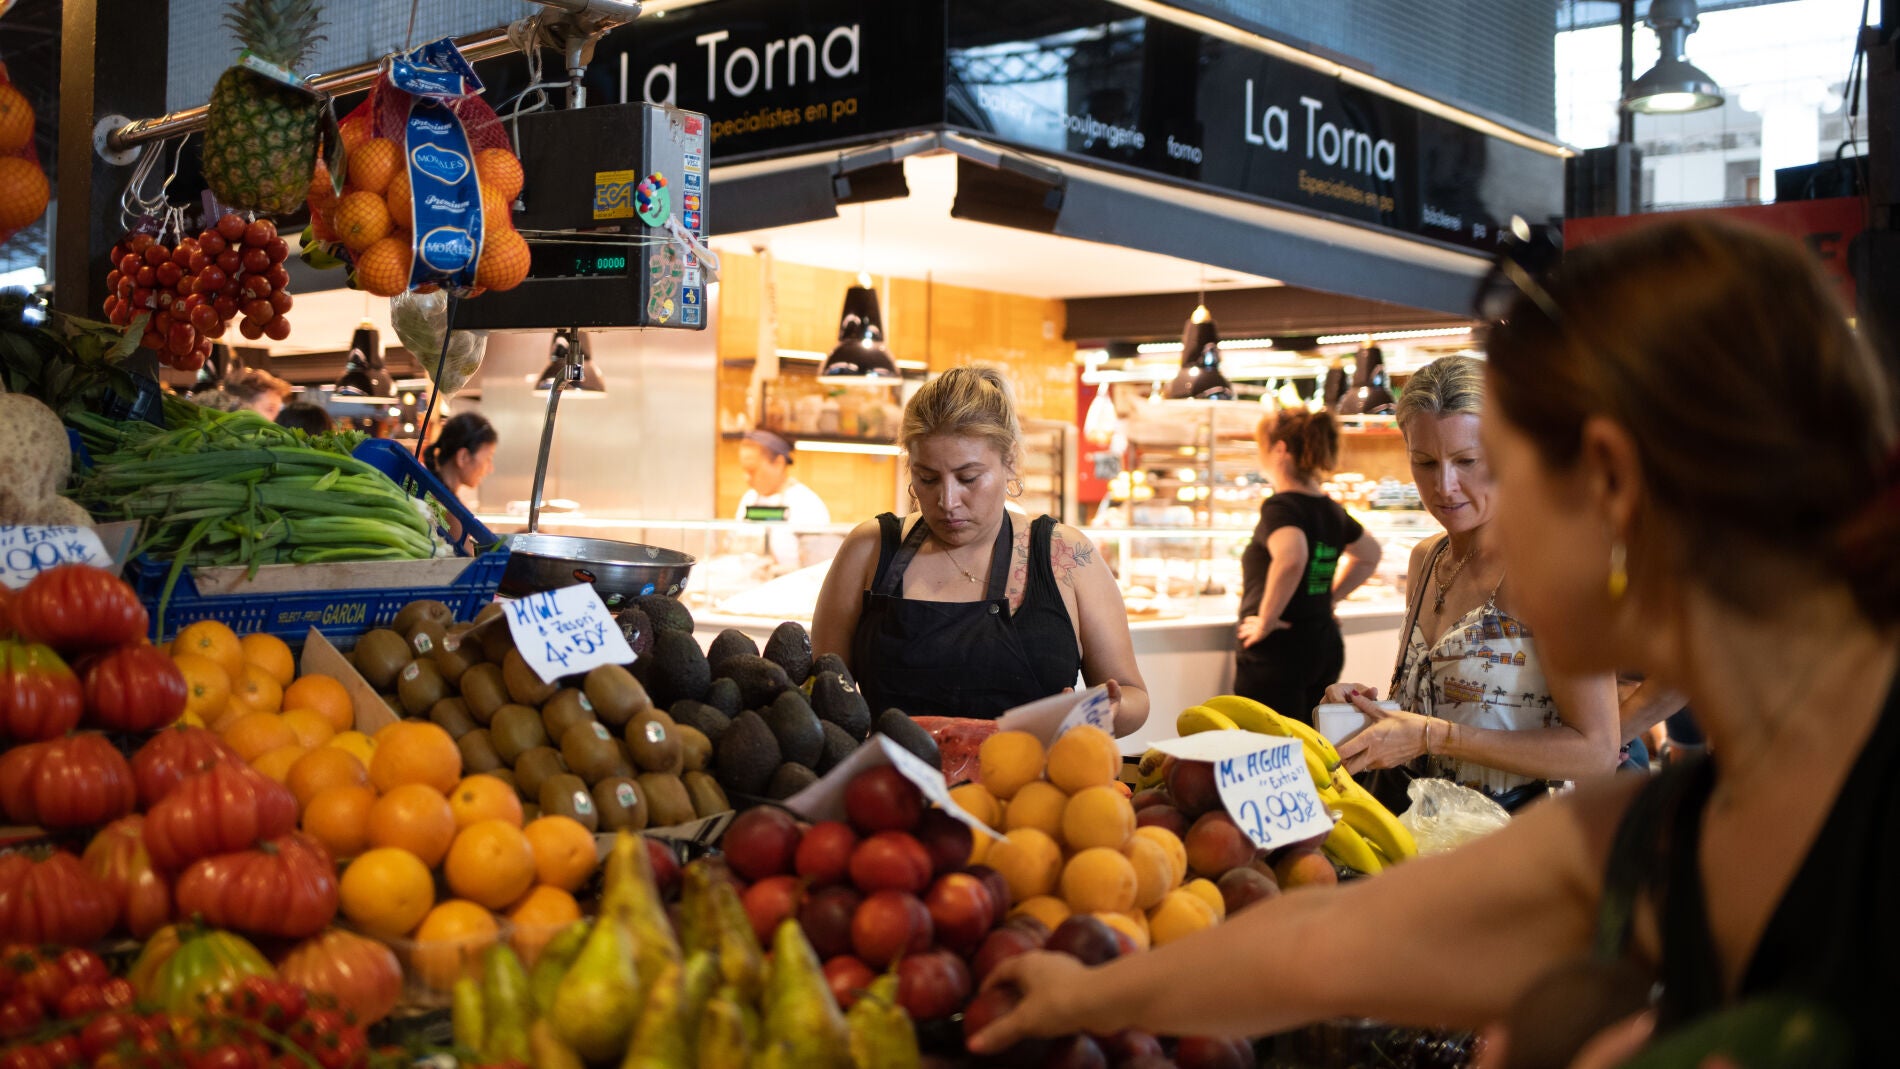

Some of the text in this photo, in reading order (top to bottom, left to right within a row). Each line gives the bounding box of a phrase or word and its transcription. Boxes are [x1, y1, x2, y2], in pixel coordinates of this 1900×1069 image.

[696, 24, 860, 101] Torna
[711, 105, 801, 144] pecialistes
[804, 102, 828, 122] en
[832, 98, 857, 124] pa
[1245, 79, 1395, 181] La Torna
[322, 603, 367, 625] GARCIA
[1220, 744, 1292, 788] M. AGUA
